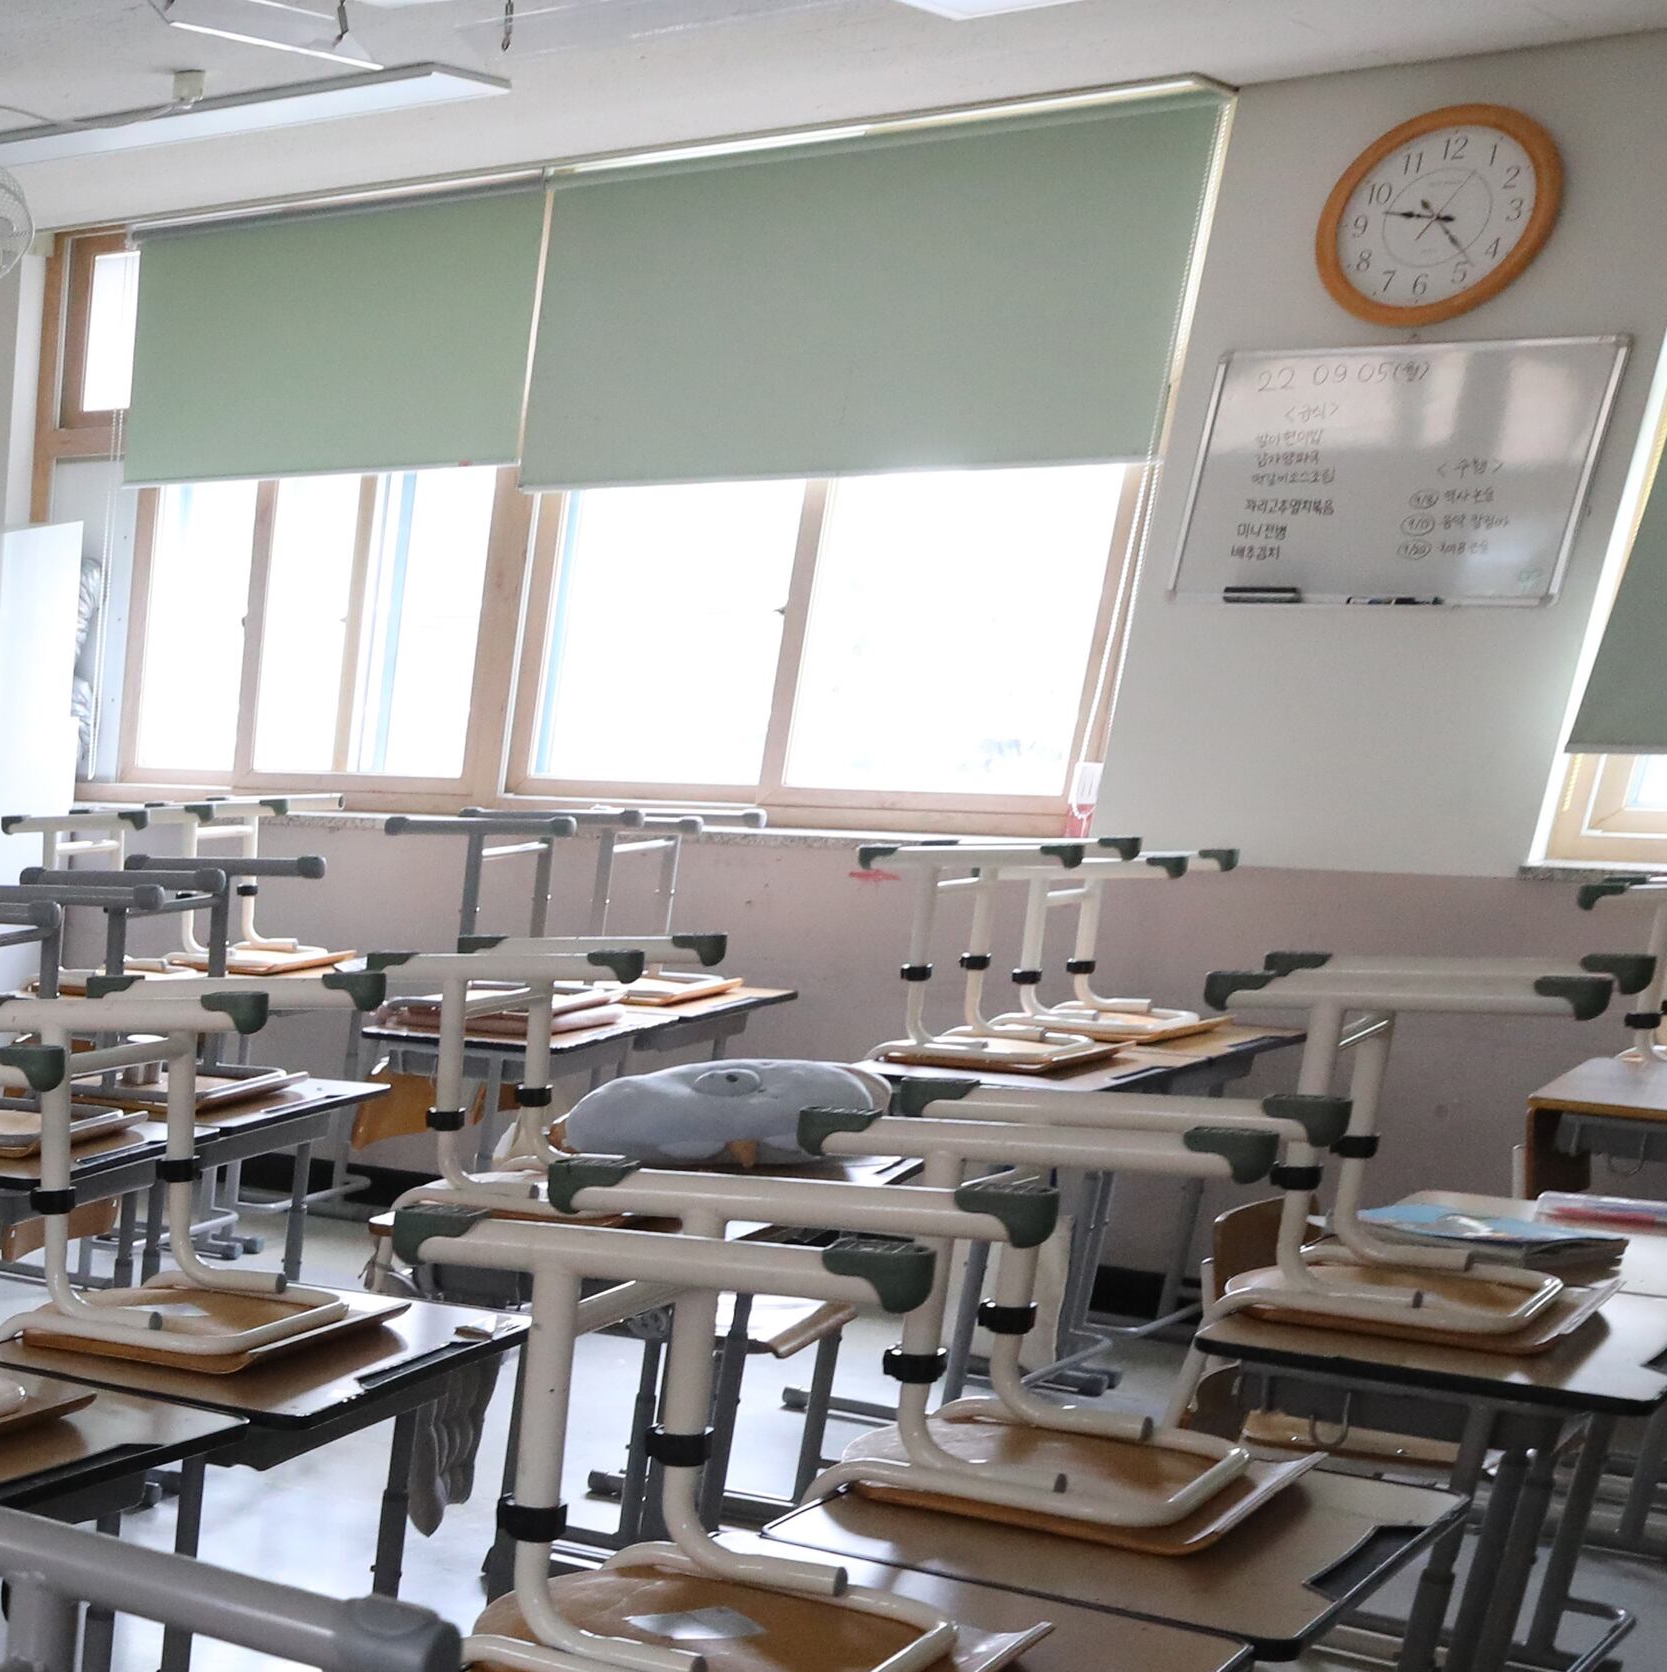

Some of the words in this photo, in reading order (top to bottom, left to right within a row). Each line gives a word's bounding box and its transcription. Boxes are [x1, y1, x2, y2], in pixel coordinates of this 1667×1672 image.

[1442, 137, 1468, 160] 12
[1489, 143, 1497, 166] 1
[1403, 152, 1424, 175] 11
[1502, 167, 1520, 190] 2
[1367, 183, 1392, 205] 10
[1505, 198, 1523, 222] 3
[1352, 215, 1368, 238] 9
[1485, 237, 1500, 259] 4
[1356, 250, 1372, 272] 8
[1451, 262, 1468, 283] 5
[1382, 271, 1396, 292] 7
[1412, 274, 1429, 296] 6
[1258, 366, 1296, 392] 22
[1313, 363, 1347, 385] 09
